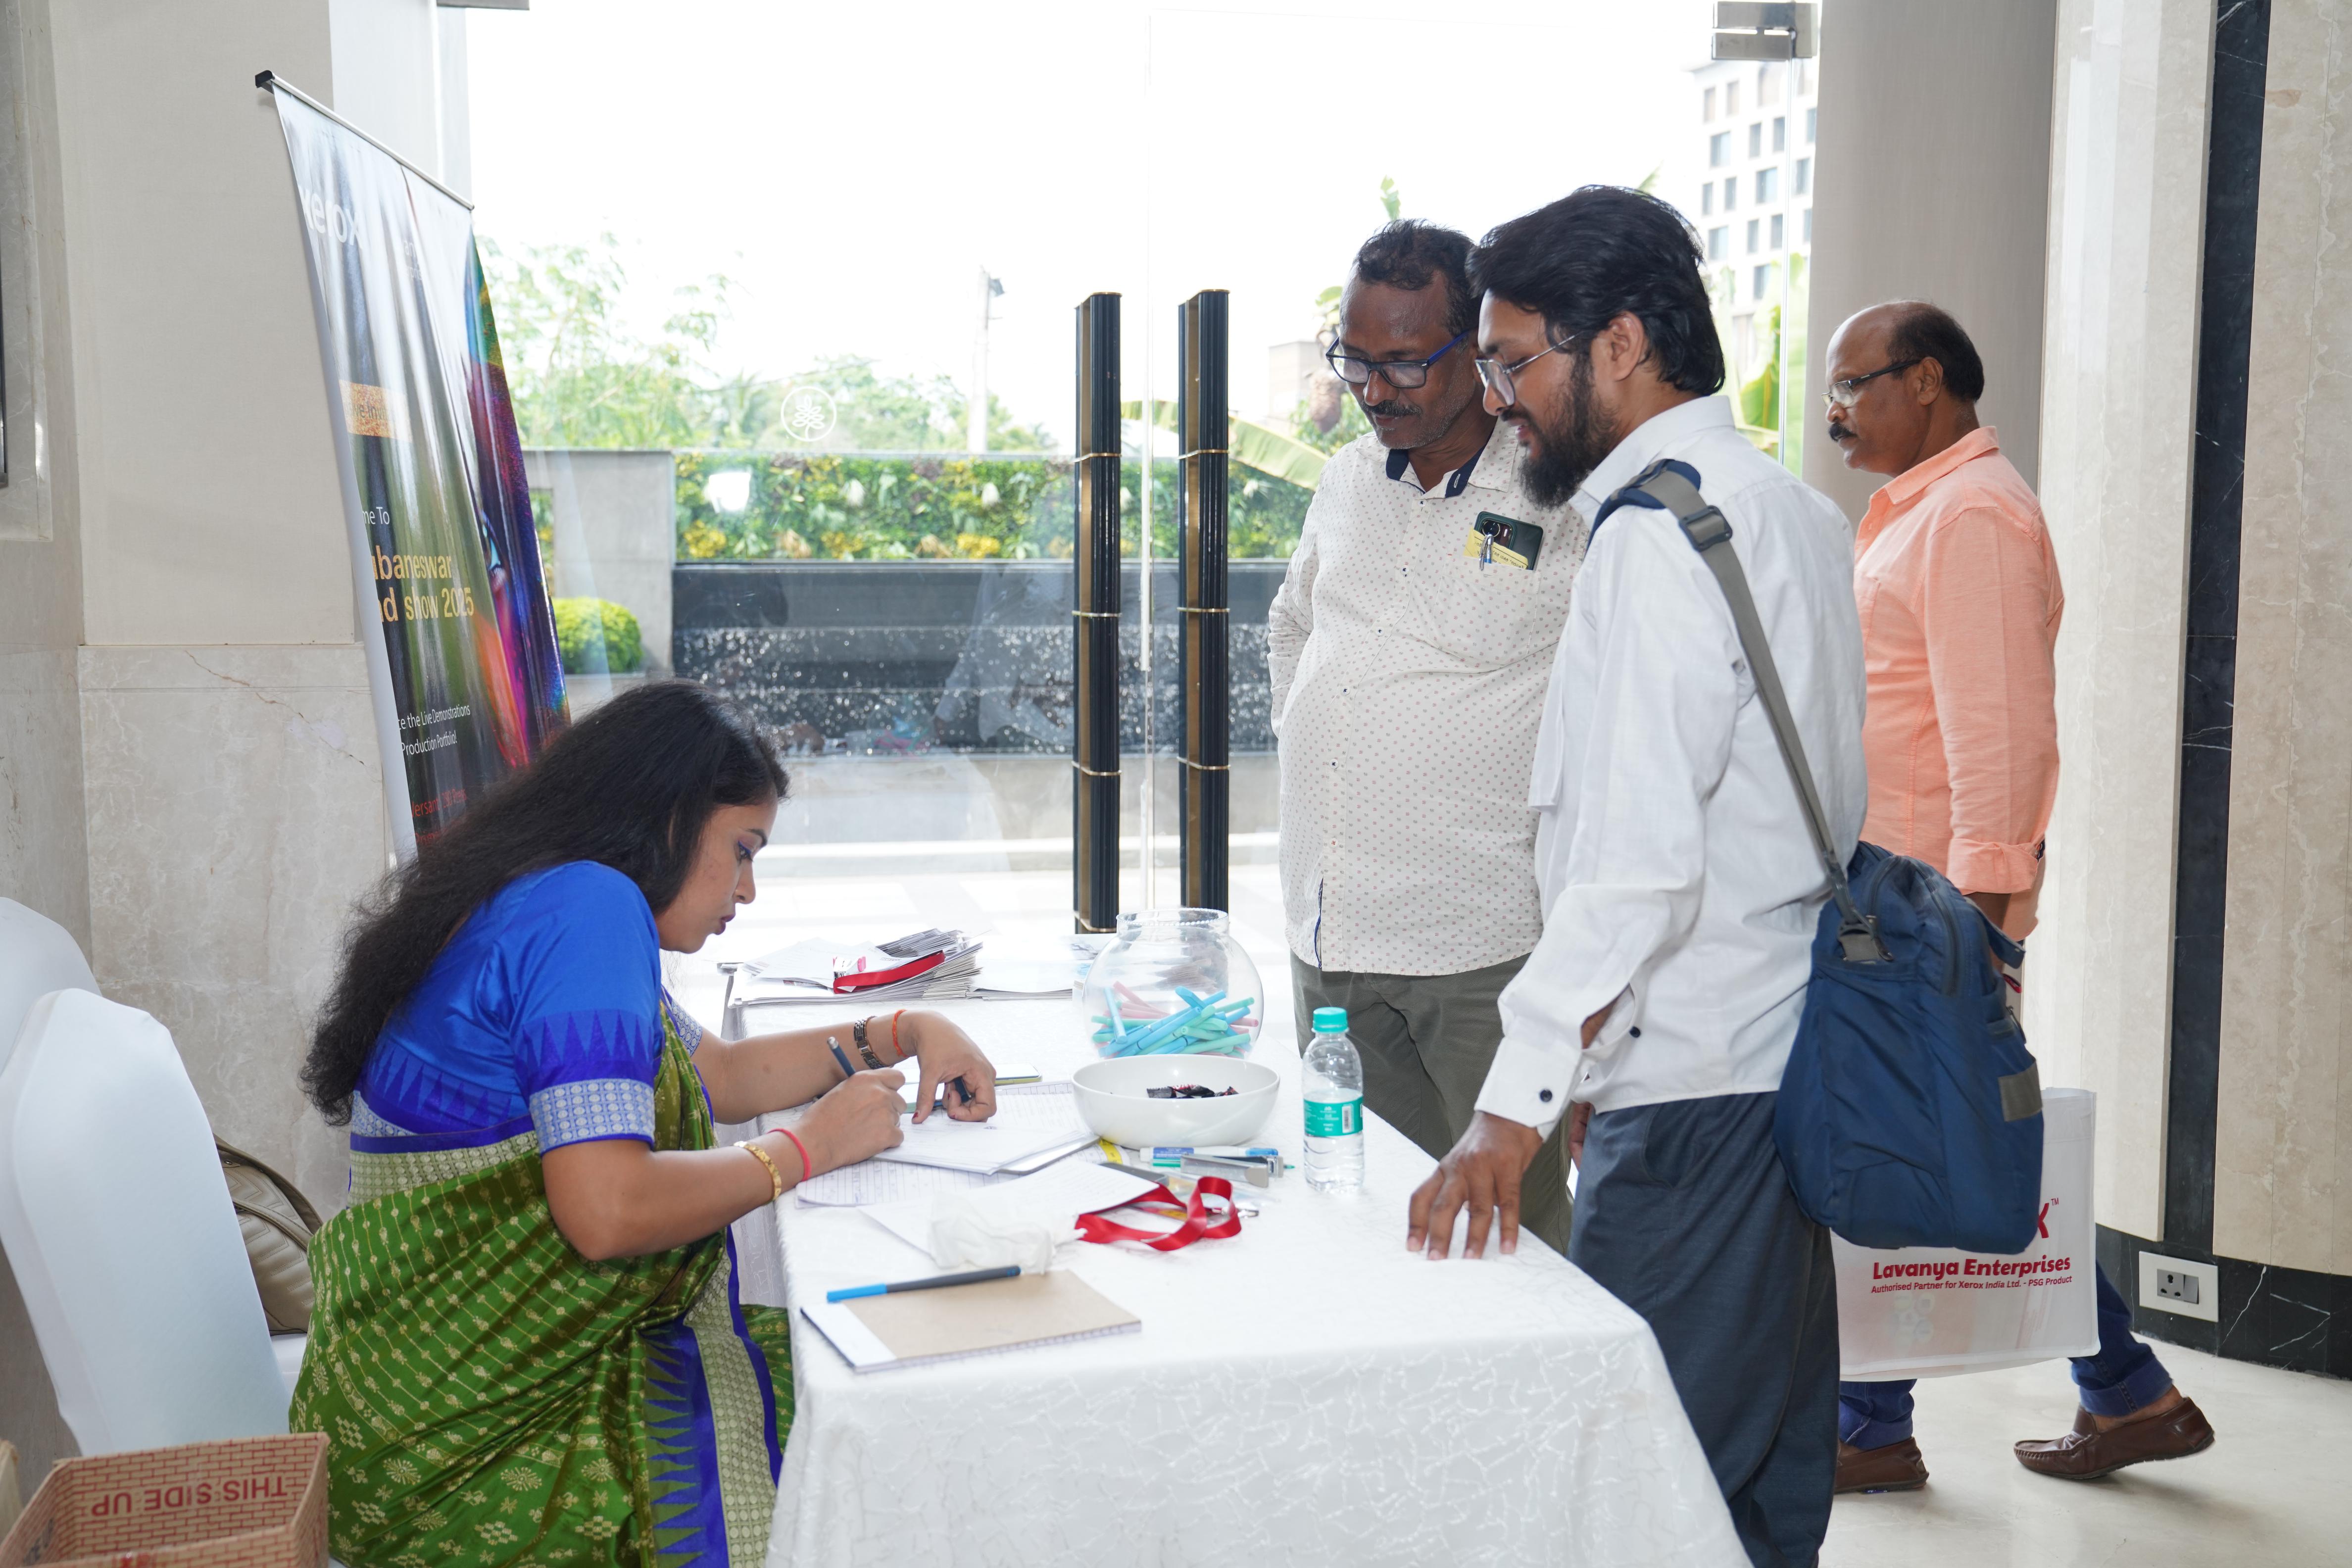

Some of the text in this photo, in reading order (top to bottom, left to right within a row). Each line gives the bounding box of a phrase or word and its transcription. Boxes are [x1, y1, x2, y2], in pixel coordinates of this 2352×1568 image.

[376, 506, 390, 525] To
[404, 587, 439, 621] show
[441, 587, 474, 618] 2025
[407, 713, 421, 729] the
[421, 711, 433, 726] Live
[432, 704, 471, 723] Demonstrations
[437, 730, 457, 749] Portfolio!
[1873, 1254, 2071, 1281] Lavanya Enterprises
[1871, 1282, 1912, 1294] Authorised
[1914, 1281, 1944, 1290] Partner
[1945, 1280, 1957, 1289] for
[1959, 1280, 1984, 1289] Xerox
[1985, 1280, 2005, 1289] India
[2007, 1280, 2021, 1288] Ltd.
[2028, 1278, 2044, 1287] PSG
[2045, 1275, 2072, 1286] Product
[91, 1476, 288, 1517] THIS SIDE UP
